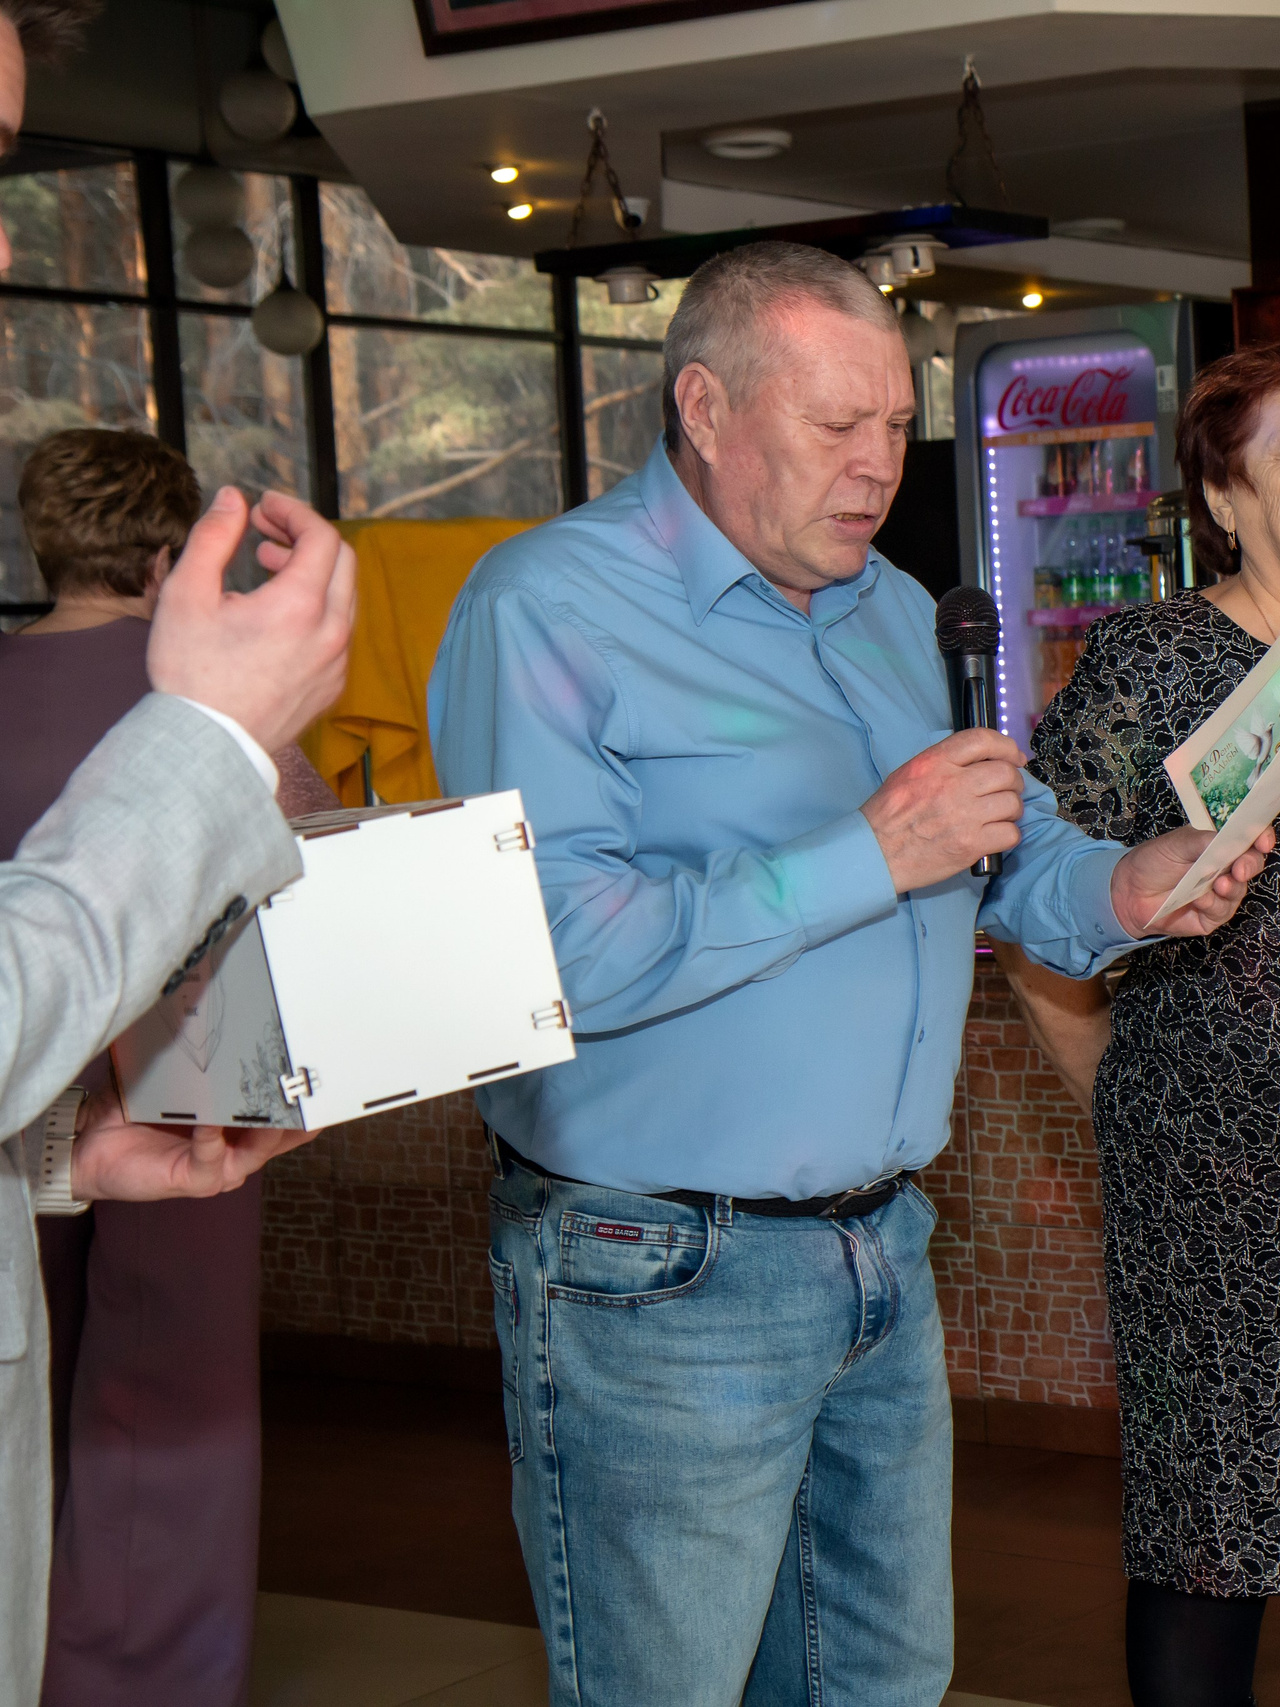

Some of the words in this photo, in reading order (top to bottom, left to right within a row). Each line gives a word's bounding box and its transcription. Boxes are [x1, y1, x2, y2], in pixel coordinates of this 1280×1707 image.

[997, 366, 1134, 430] Coca-Cola
[1201, 761, 1210, 778] В
[1209, 742, 1232, 766] День
